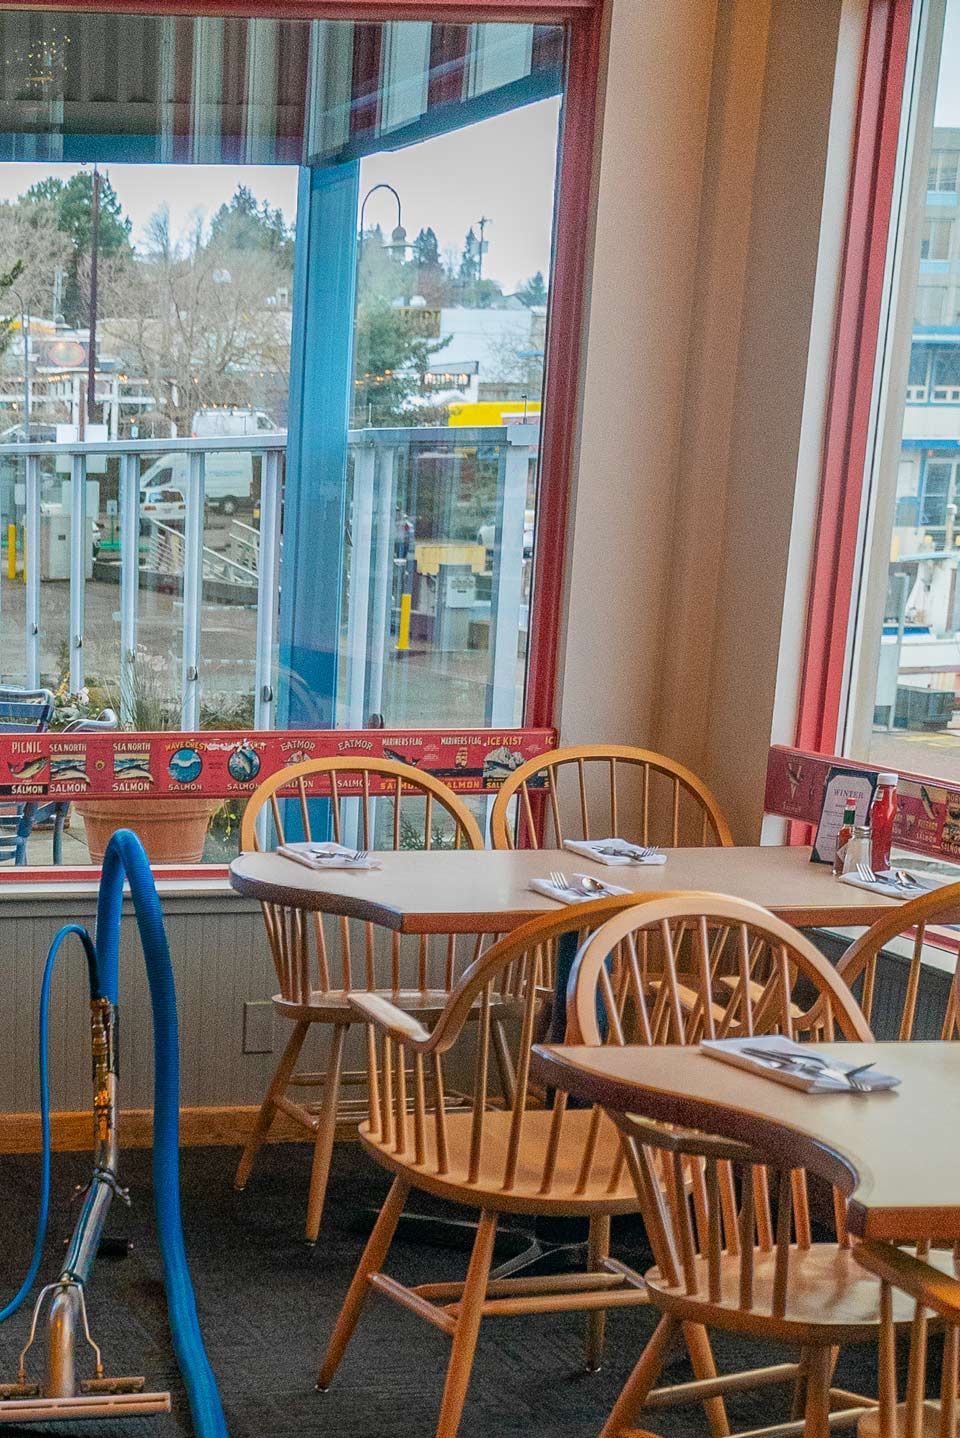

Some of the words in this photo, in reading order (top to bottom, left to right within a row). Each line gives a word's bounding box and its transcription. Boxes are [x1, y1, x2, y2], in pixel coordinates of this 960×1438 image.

[337, 739, 373, 751] EATMOR
[409, 737, 423, 746] FLAG
[468, 736, 482, 745] FLAG
[487, 737, 502, 746] ICE
[504, 736, 522, 746] KIST
[11, 741, 42, 754] PICNIC
[49, 744, 62, 752] SEA
[63, 743, 87, 752] NORTH
[112, 743, 126, 751] SEA
[127, 742, 151, 751] NORTH
[164, 742, 184, 752] WAVE
[280, 740, 316, 752] EATMOR
[11, 785, 43, 794] SALMON
[49, 783, 87, 793] SALMON
[113, 783, 150, 792] SALMON
[168, 783, 202, 791] SALMON
[833, 788, 864, 799] WINTER
